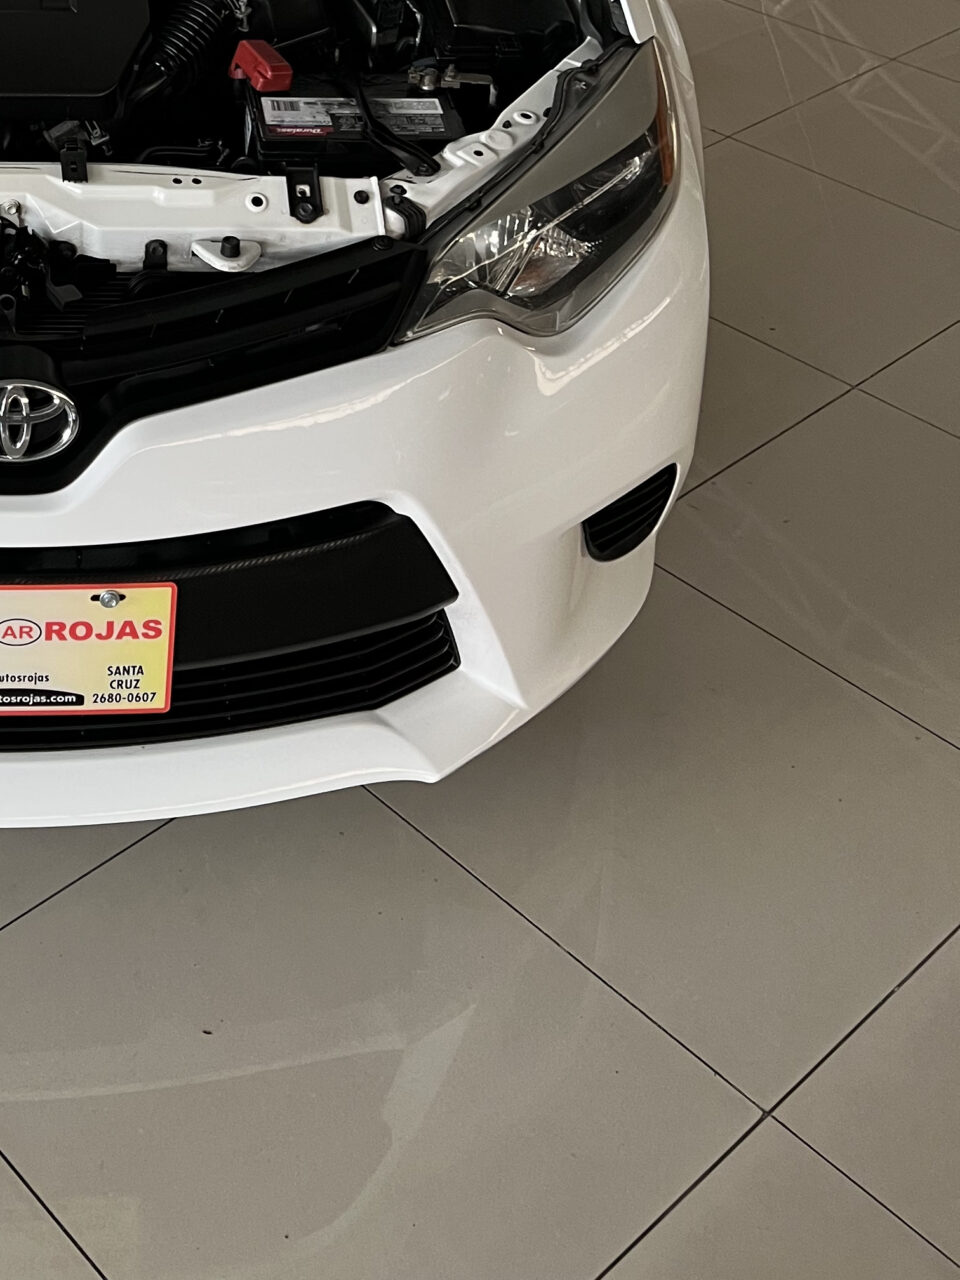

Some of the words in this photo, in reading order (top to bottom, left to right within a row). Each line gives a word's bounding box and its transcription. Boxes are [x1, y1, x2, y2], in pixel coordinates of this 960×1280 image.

[2, 625, 33, 640] AR
[44, 619, 163, 642] ROJAS
[107, 665, 145, 677] SANTA
[109, 678, 141, 690] CRUZ
[92, 692, 157, 704] 2680-0607
